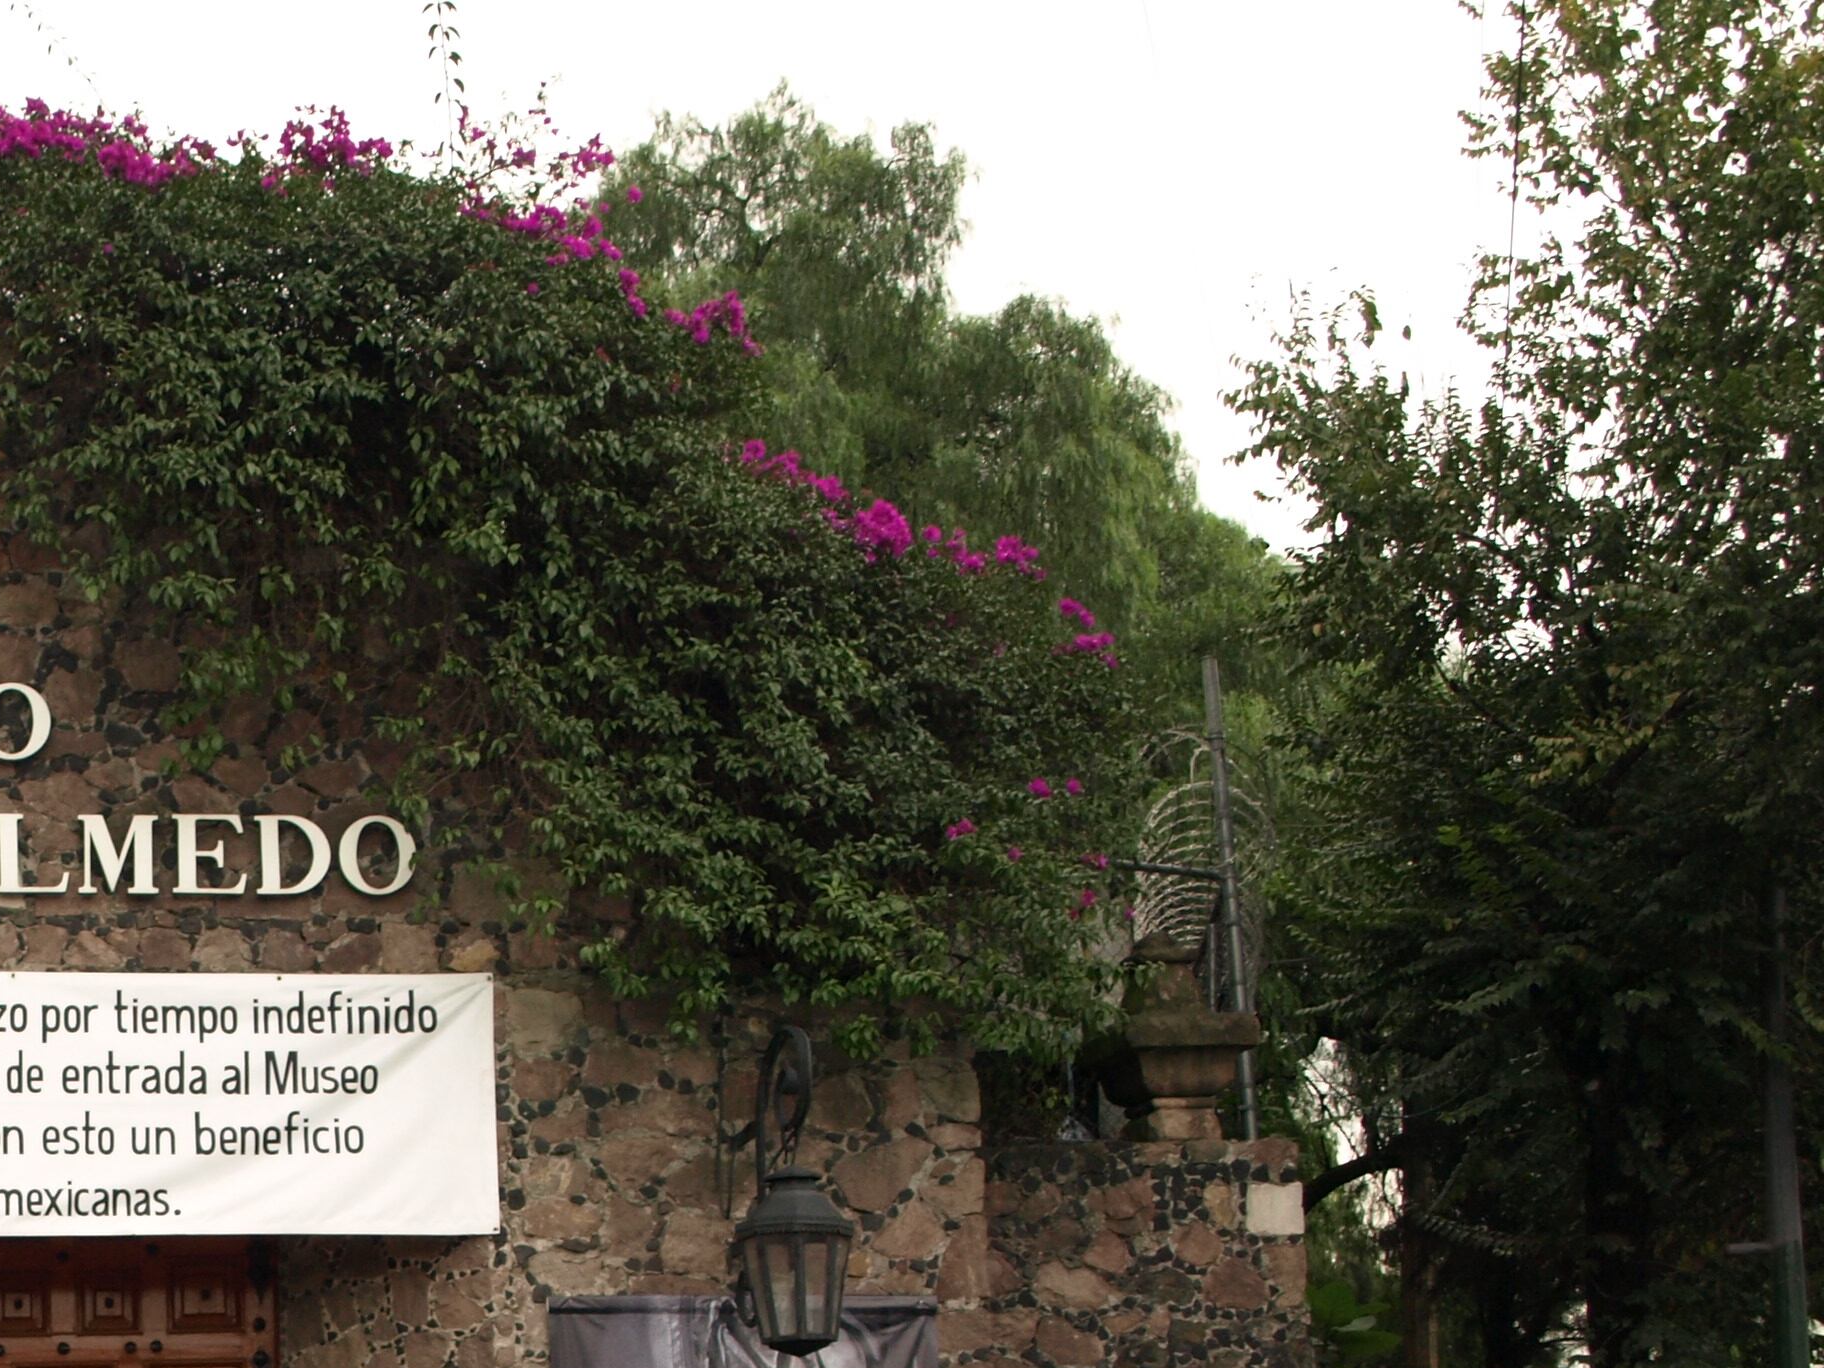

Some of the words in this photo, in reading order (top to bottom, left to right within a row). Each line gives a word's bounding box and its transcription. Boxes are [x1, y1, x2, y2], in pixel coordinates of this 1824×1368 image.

[41, 1004, 99, 1044] por
[114, 989, 238, 1044] tiempo
[253, 989, 438, 1035] indefinido
[6, 1049, 44, 1094] de
[62, 1050, 207, 1095] entrada
[221, 1050, 250, 1095] al
[264, 1050, 379, 1095] Museo
[42, 1110, 115, 1155] esto
[131, 1126, 176, 1155] un
[194, 1110, 364, 1156] beneficio
